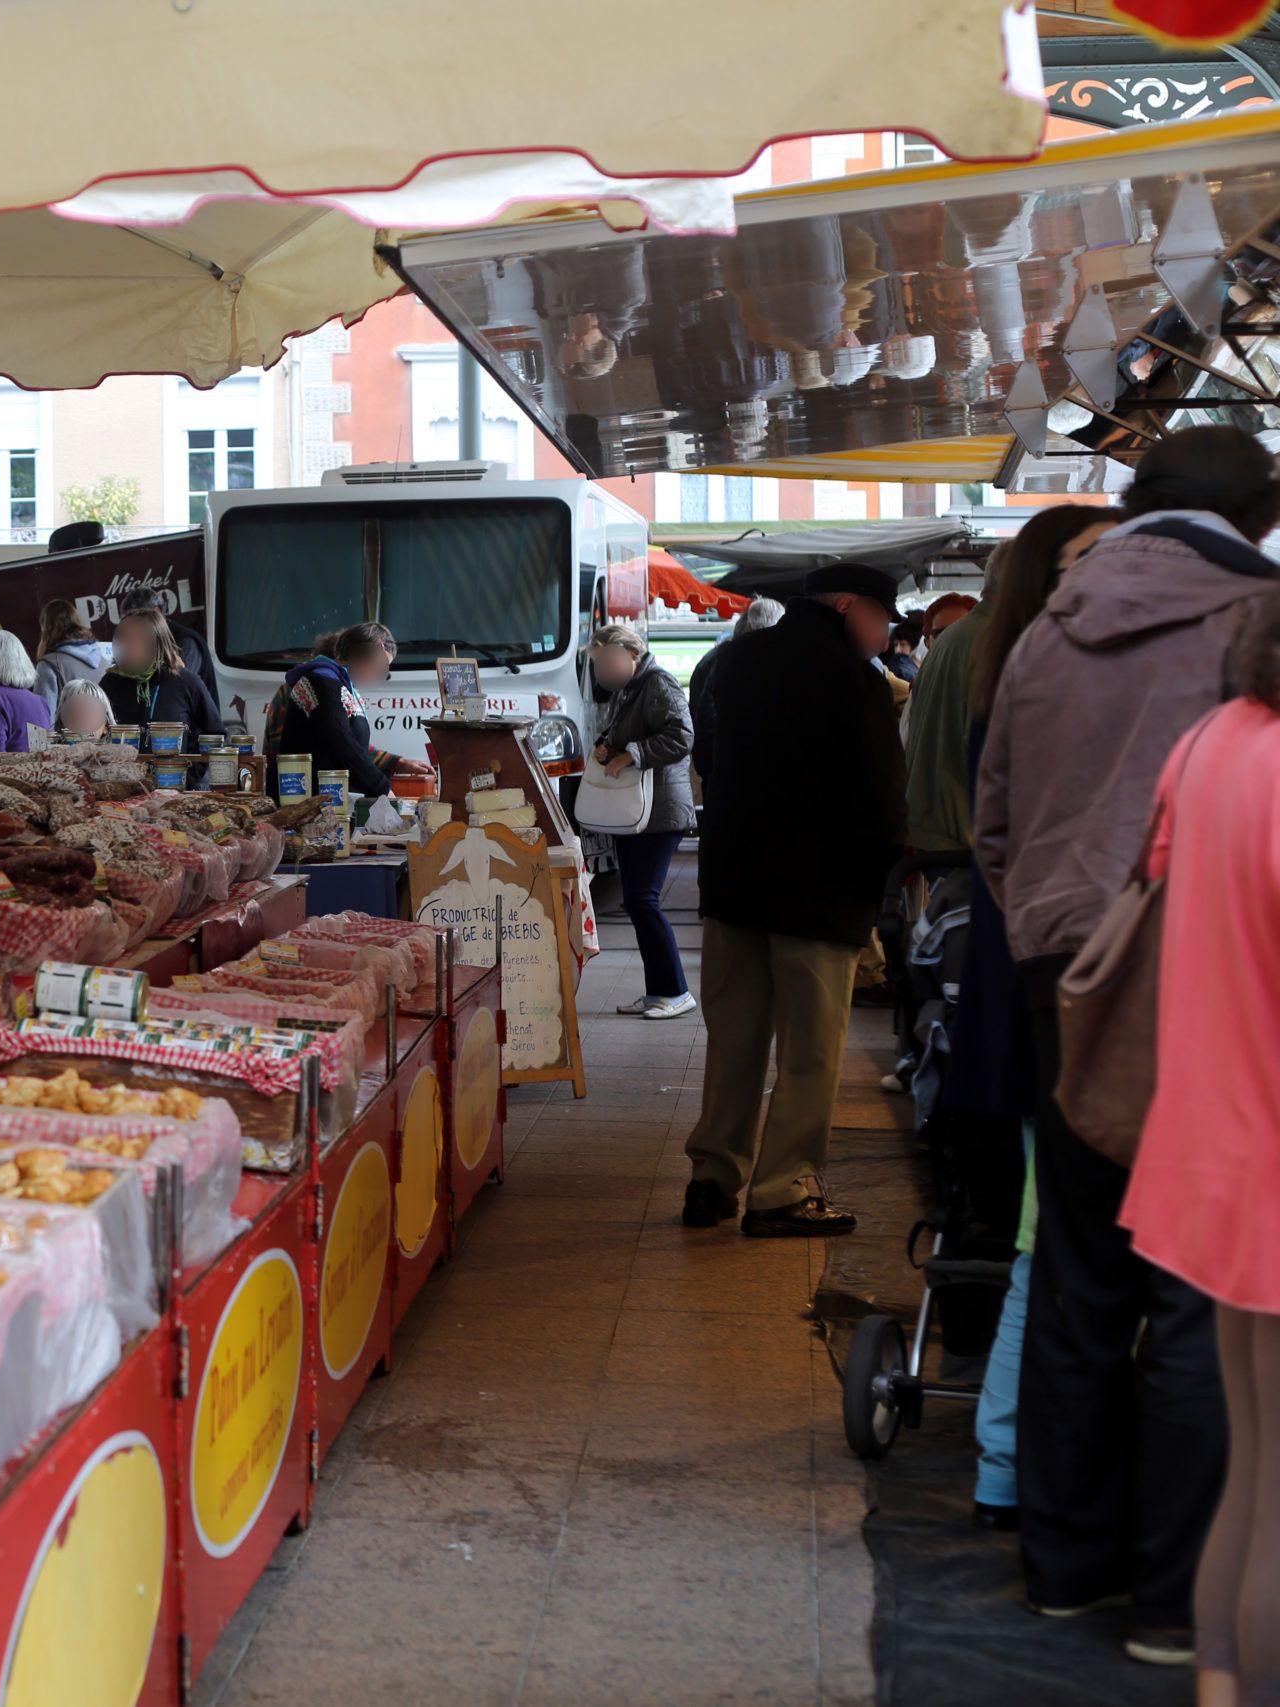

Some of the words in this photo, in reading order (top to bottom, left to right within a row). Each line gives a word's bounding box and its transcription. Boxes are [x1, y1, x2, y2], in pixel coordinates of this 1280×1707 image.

[105, 565, 173, 597] Michel
[75, 578, 205, 628] PUOL
[374, 715, 396, 730] 67
[402, 715, 421, 730] 01
[432, 905, 503, 925] PRODUCTRIC
[508, 908, 519, 922] de
[482, 926, 493, 940] de
[501, 922, 541, 941] BREBIS
